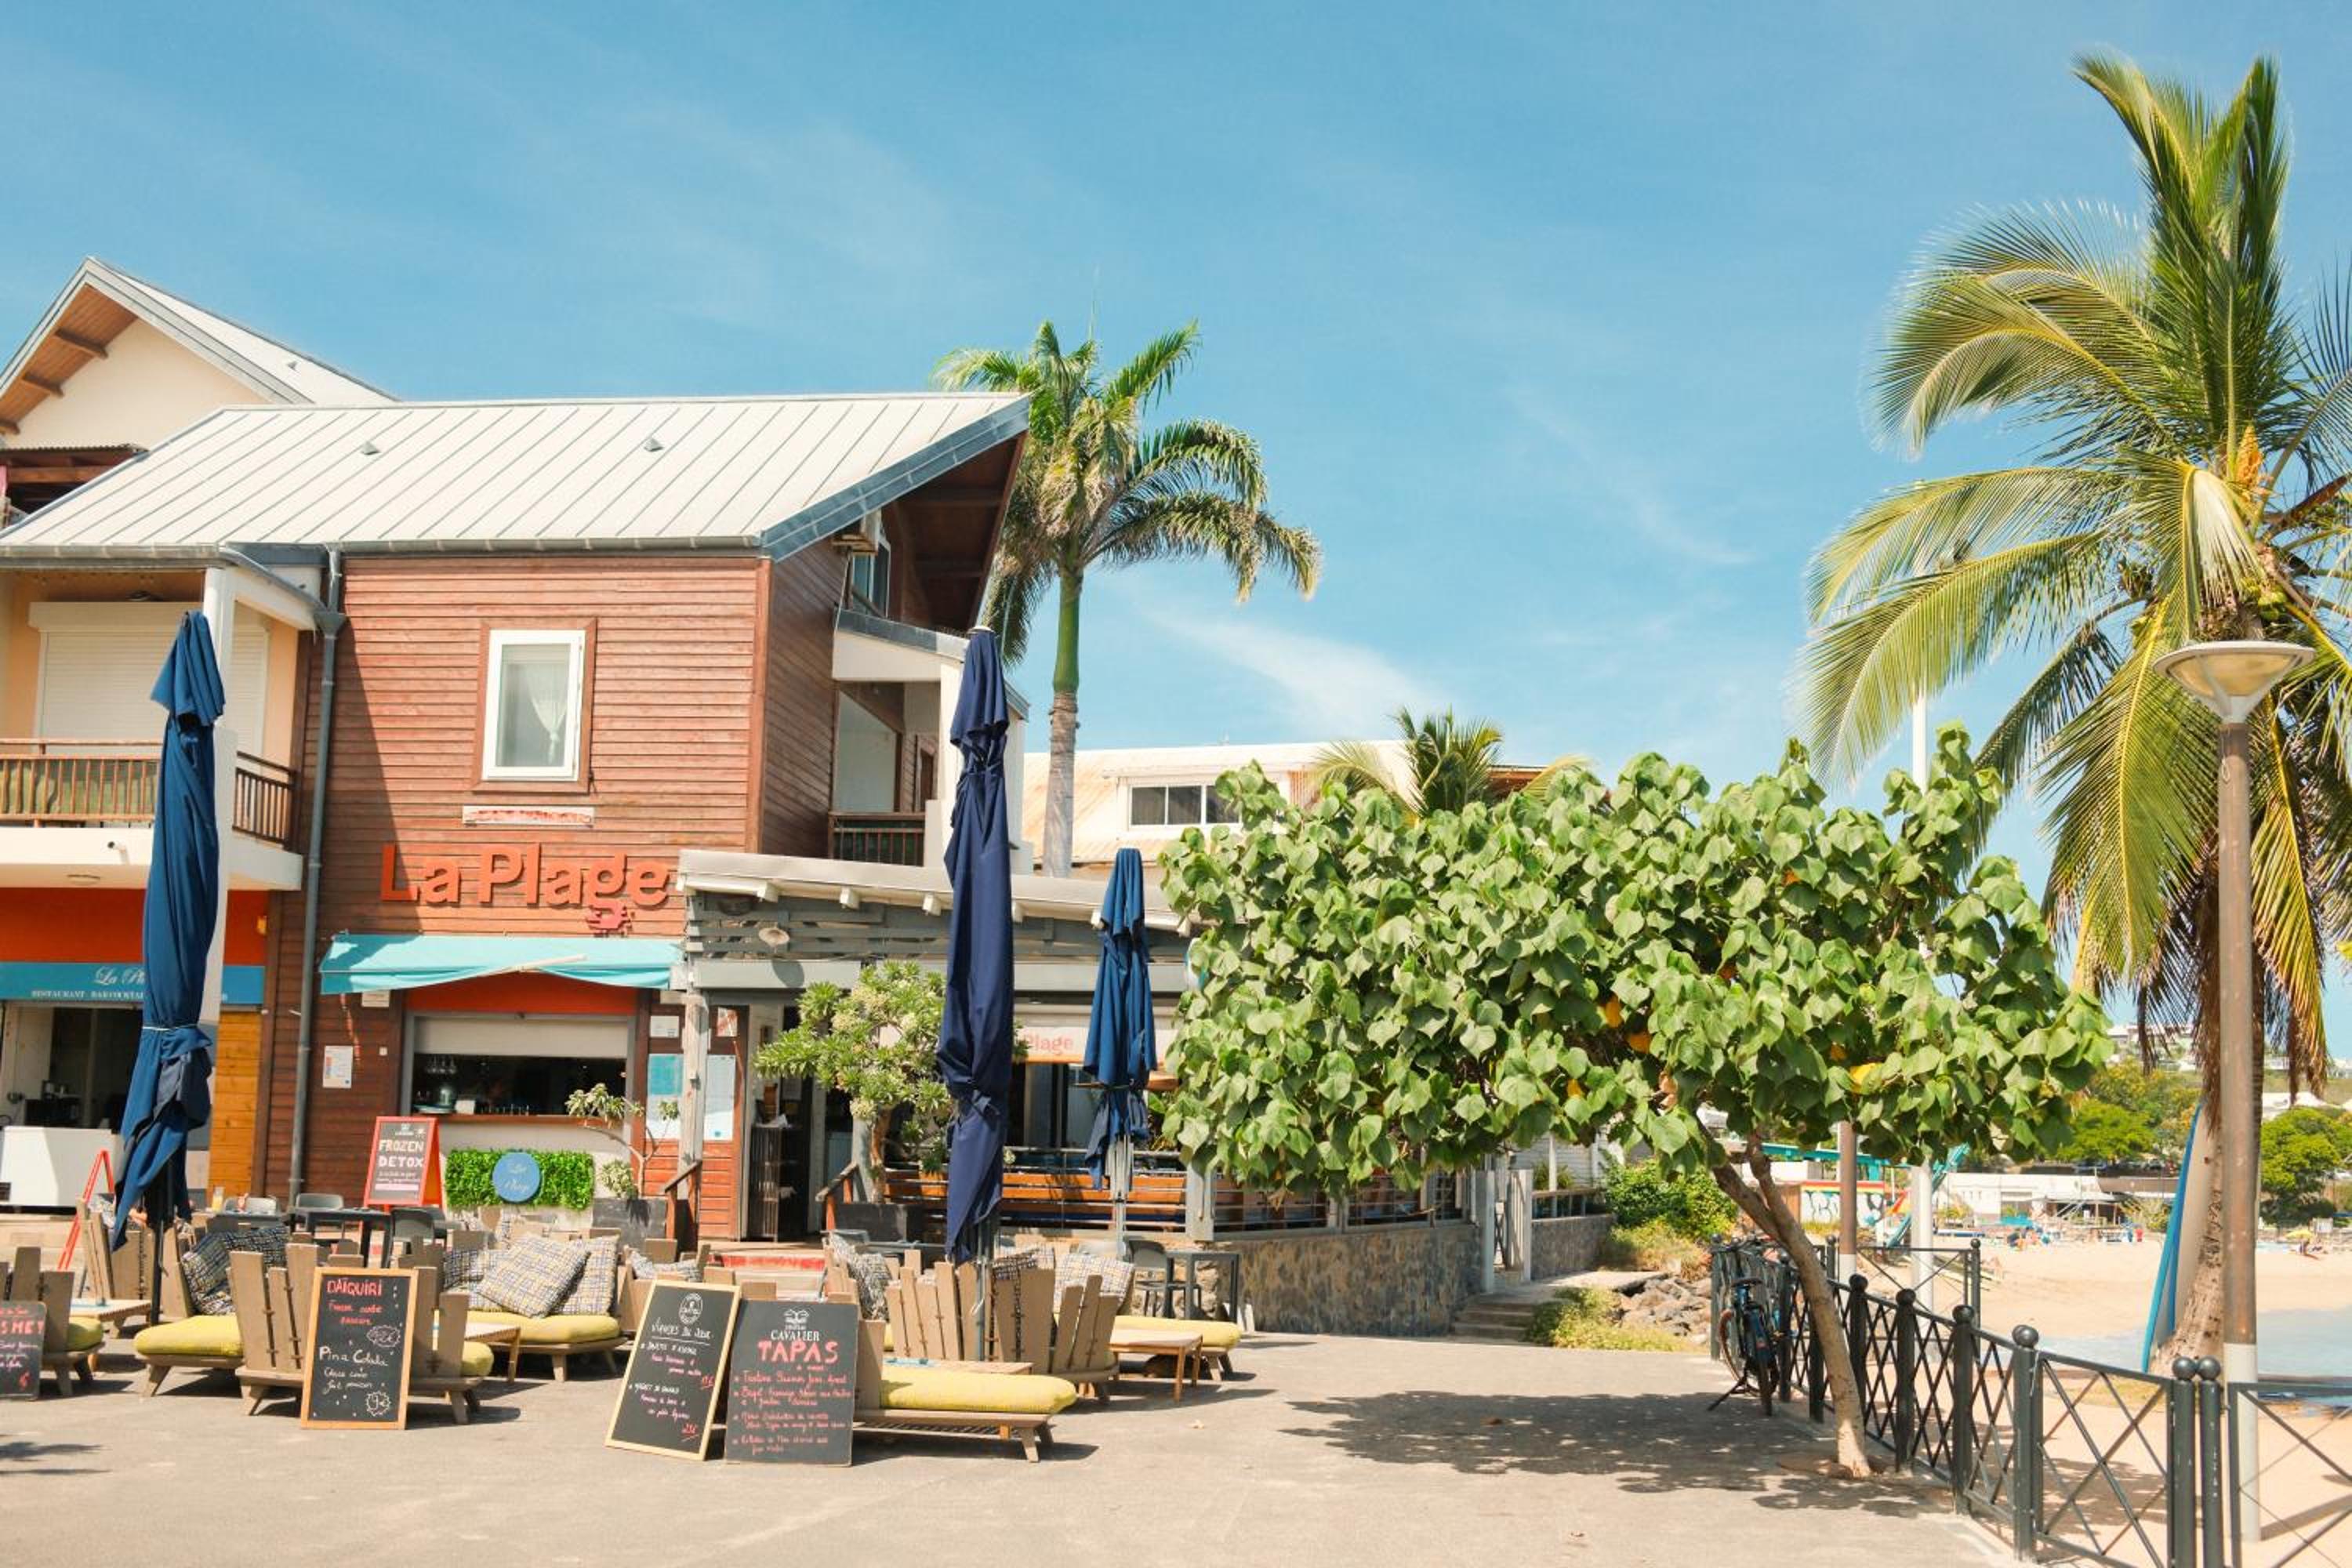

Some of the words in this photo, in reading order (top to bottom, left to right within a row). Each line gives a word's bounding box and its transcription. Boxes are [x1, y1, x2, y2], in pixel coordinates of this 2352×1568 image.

[380, 844, 463, 906] La
[479, 842, 671, 935] Plage
[379, 1138, 424, 1152] FROZEN
[378, 1155, 424, 1167] DETOX
[771, 1330, 820, 1341] CAVALIER
[757, 1340, 839, 1364] TAPAS
